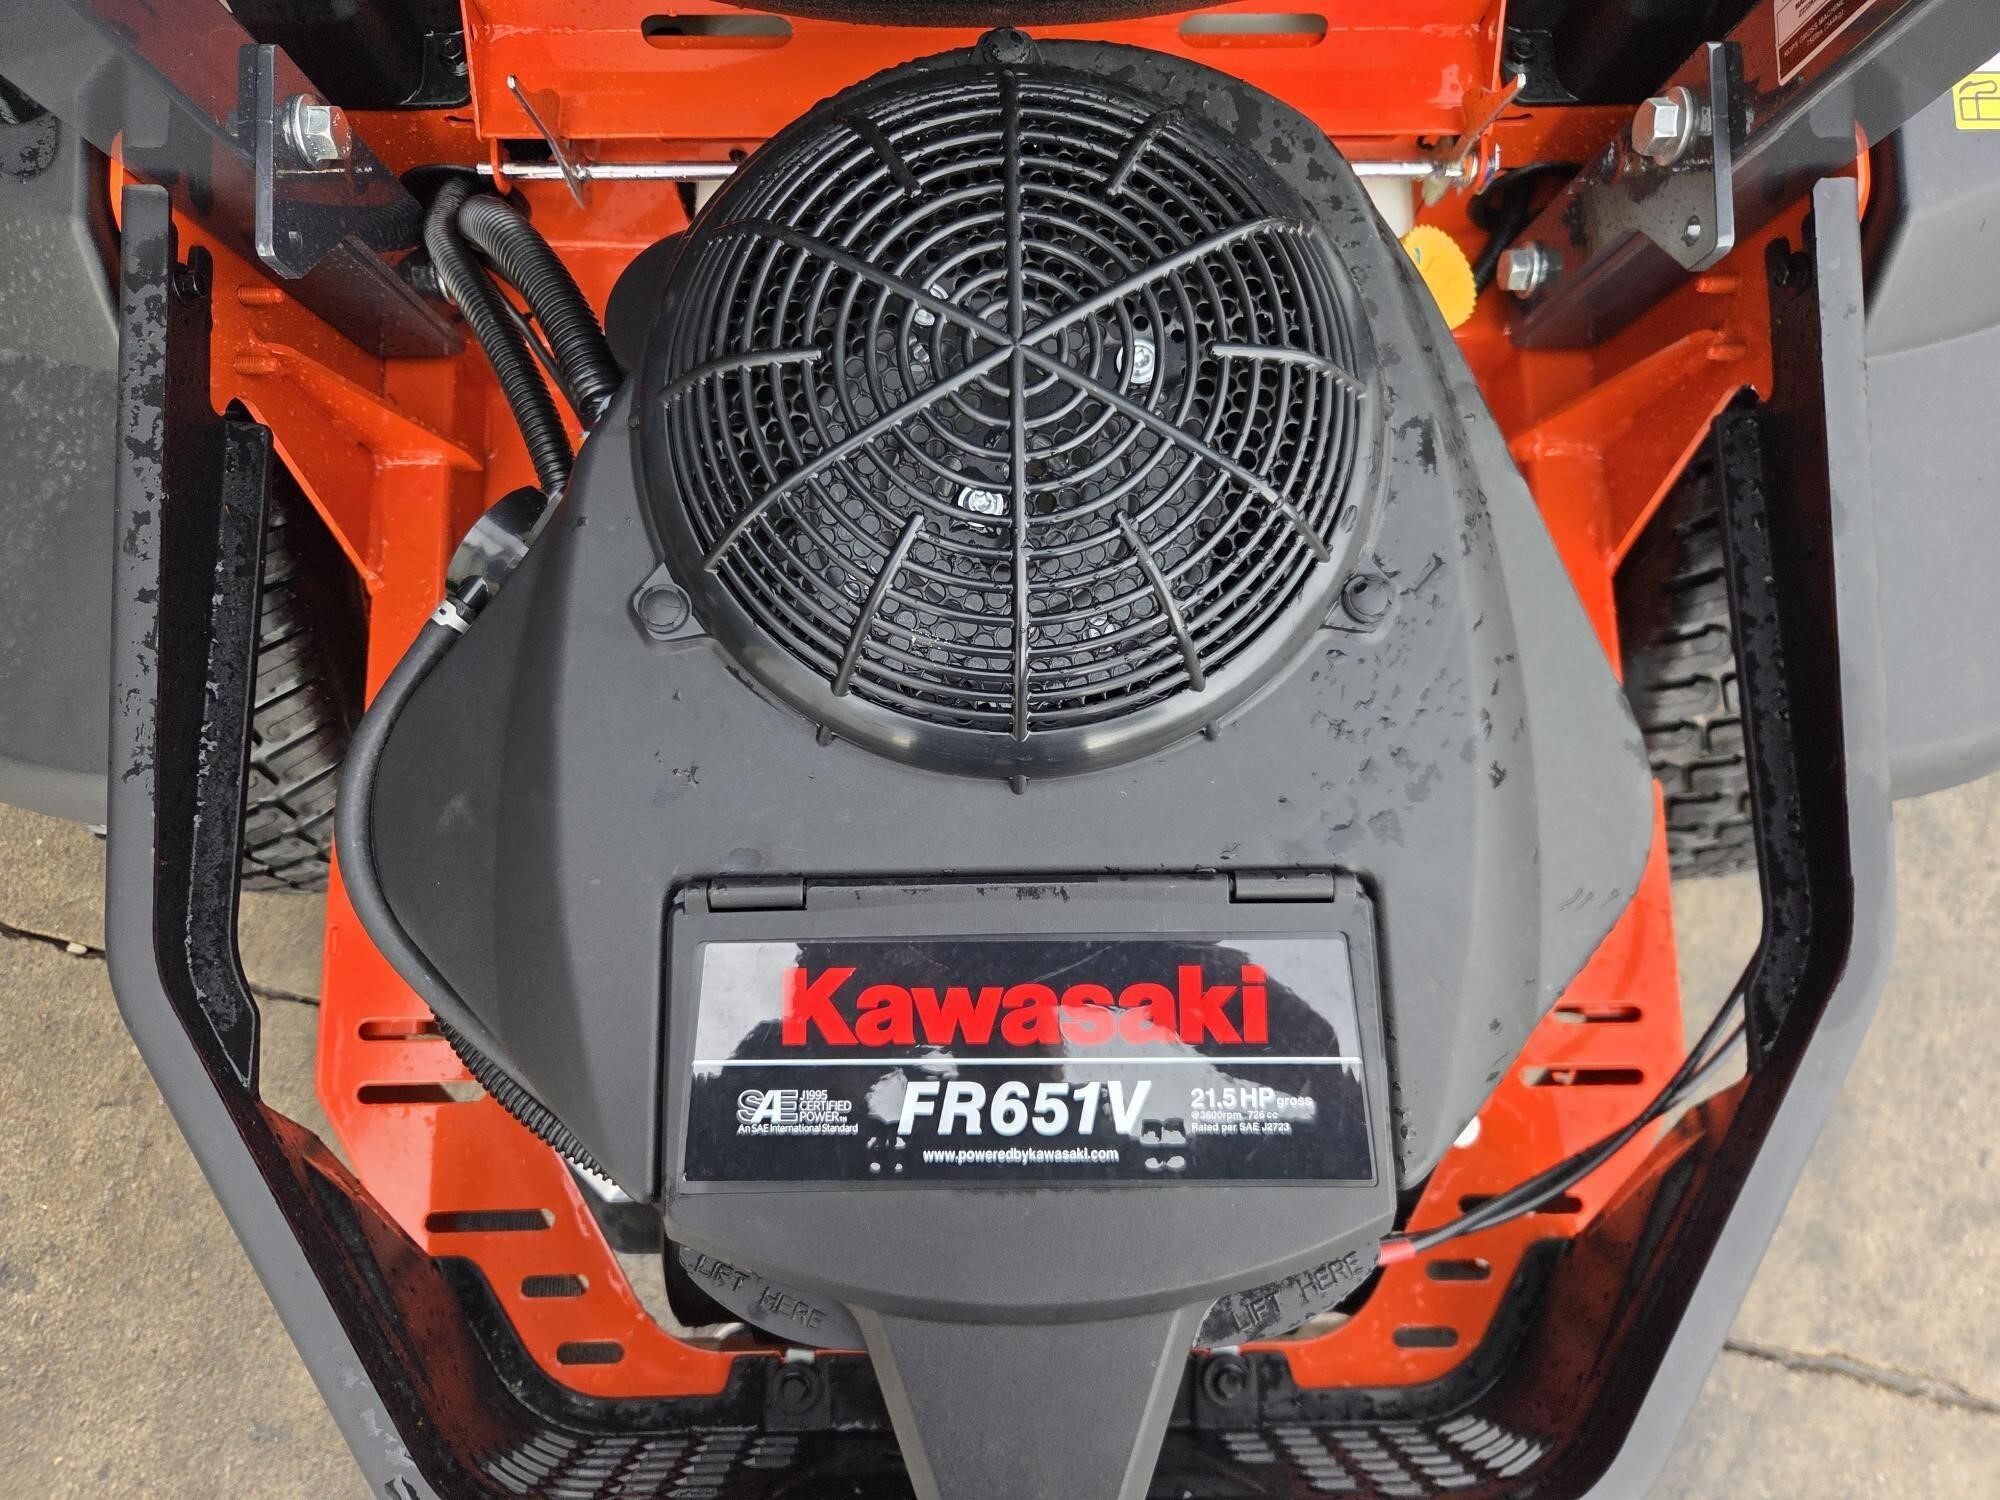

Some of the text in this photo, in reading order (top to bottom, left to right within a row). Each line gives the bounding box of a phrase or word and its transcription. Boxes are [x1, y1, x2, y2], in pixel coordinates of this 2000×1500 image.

[781, 966, 1269, 1047] Kawasaki
[799, 1089, 828, 1101] J1995
[1190, 1087, 1313, 1109] 21.5 HP gross
[738, 1090, 799, 1123] SAE
[799, 1100, 852, 1111] CERTIFIED
[897, 1080, 1152, 1137] FR651V
[1190, 1110, 1279, 1122] @3600rpm 726 cc
[738, 1123, 858, 1133] An SAE International Standard
[1191, 1122, 1291, 1135] Rated per SAE J2723
[923, 1148, 1119, 1165] www.poweredbykawasaki.com
[694, 1253, 827, 1328] LIFT HERE
[1231, 1250, 1364, 1333] LIFT HERE
